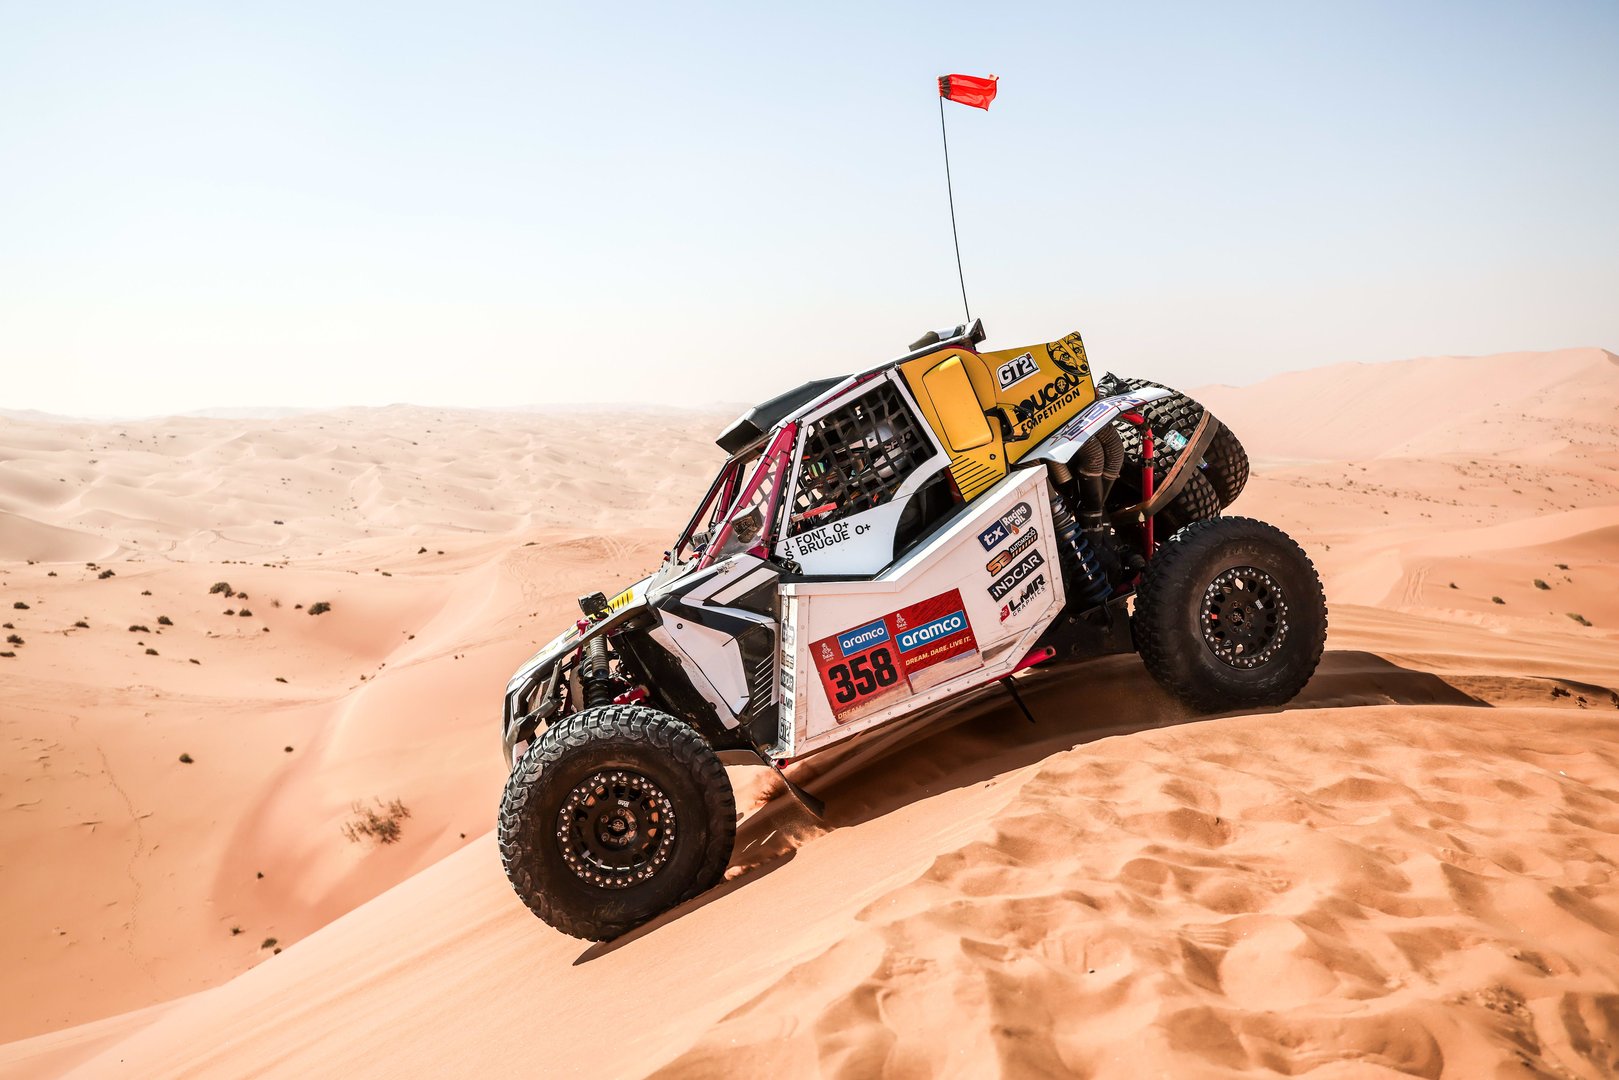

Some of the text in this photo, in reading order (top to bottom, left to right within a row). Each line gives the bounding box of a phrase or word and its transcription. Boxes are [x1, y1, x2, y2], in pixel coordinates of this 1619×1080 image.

[1021, 389, 1080, 432] COMPETITION
[1003, 505, 1027, 526] Racing
[784, 542, 794, 551] J.
[796, 528, 826, 546] FONT
[786, 551, 794, 560] S
[800, 530, 850, 556] BRUGUE
[1008, 574, 1046, 612] LMR
[1012, 587, 1046, 616] GRAPHICS
[842, 627, 885, 649] aramco
[902, 616, 962, 646] aramco
[906, 636, 972, 666] DREAM. DARE. LIVE IT.
[828, 647, 898, 704] 358
